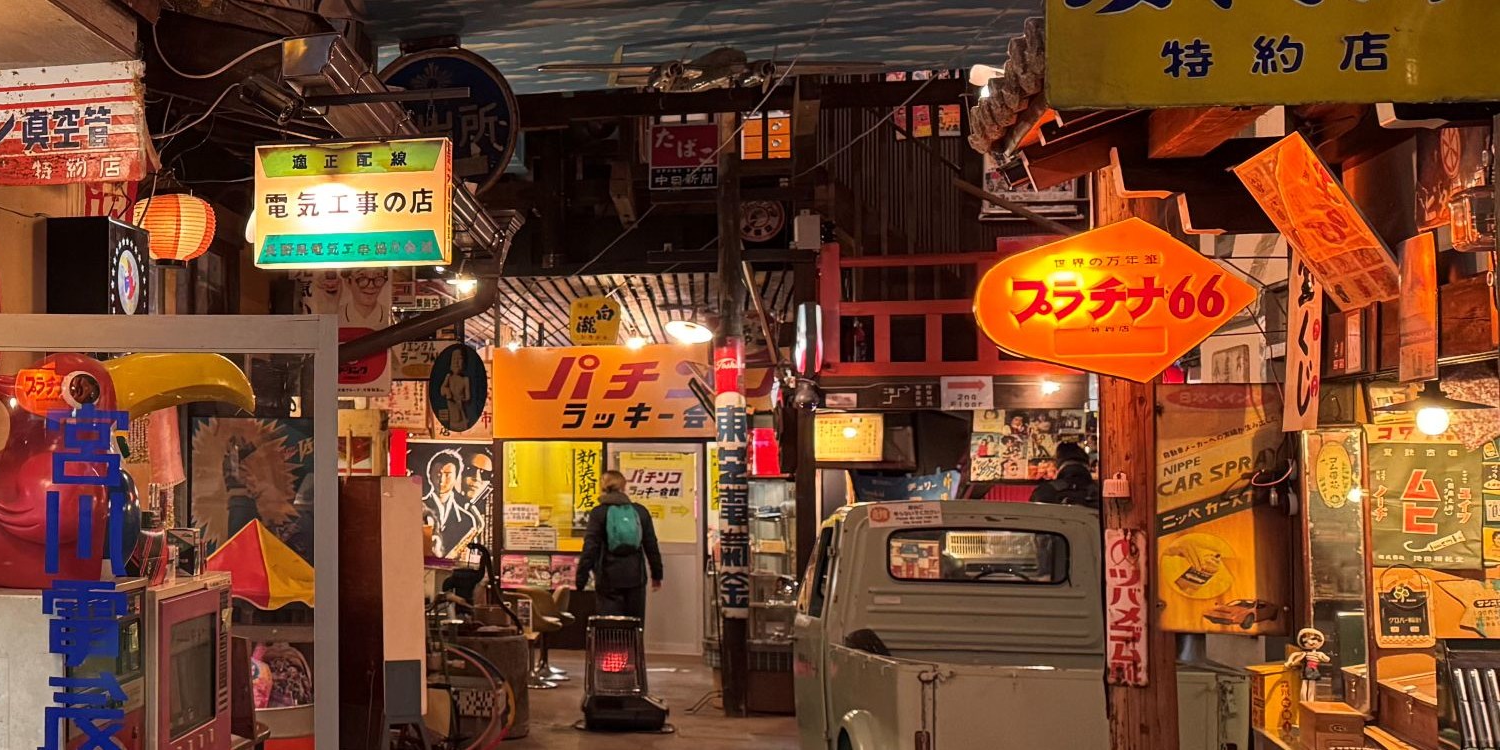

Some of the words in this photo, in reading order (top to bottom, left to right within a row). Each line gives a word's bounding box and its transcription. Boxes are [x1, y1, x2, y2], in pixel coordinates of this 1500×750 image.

[1161, 32, 1392, 78] 特約店
[655, 128, 714, 164] たばこ
[32, 157, 123, 180] 特約店
[292, 151, 407, 170] 適正配線
[654, 173, 714, 186] 中日新聞
[265, 188, 434, 219] 電気工事の店
[1054, 254, 1161, 268] 世界の万年筆
[1011, 274, 1227, 326] プラチナ66
[627, 468, 682, 484] パチンコ
[1163, 456, 1202, 477] NIPPE
[628, 486, 680, 498] ラッキー会館
[1157, 472, 1203, 497] CAR
[1162, 496, 1202, 529] ニッペ
[1401, 469, 1441, 535] ムヒ
